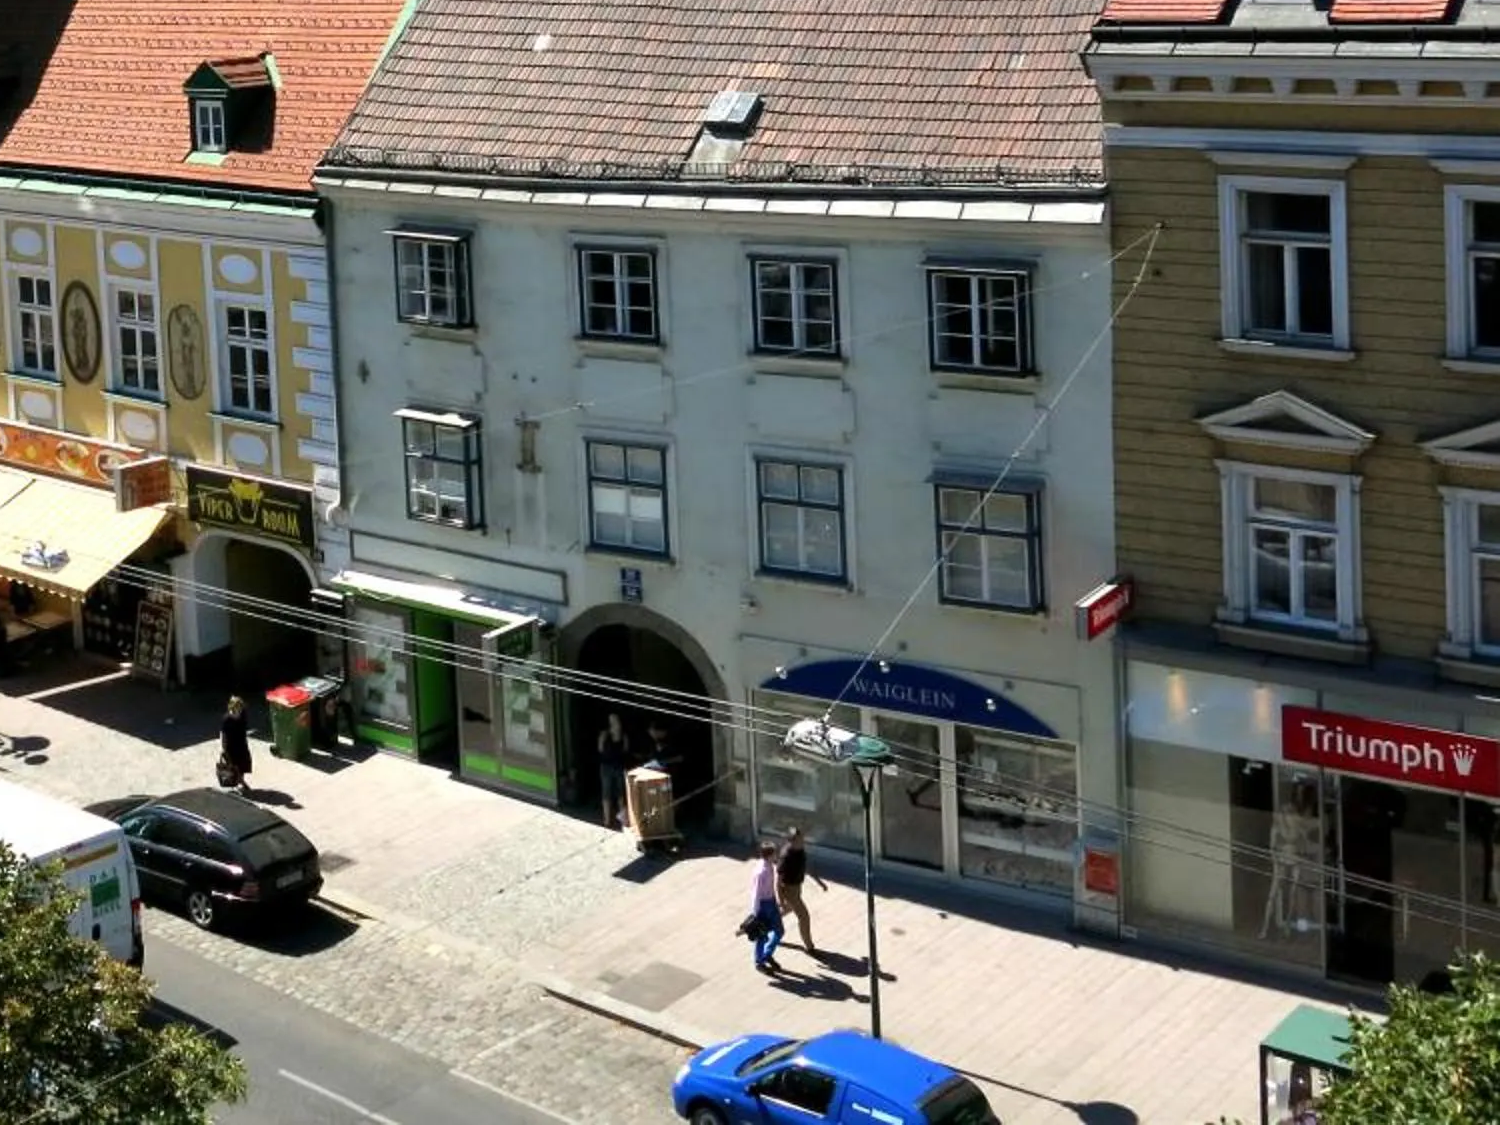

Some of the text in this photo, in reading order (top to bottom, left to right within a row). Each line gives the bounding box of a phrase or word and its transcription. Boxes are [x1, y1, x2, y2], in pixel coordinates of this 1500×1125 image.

[196, 489, 301, 538] VIPER ROOM
[850, 676, 956, 709] WAIGLEIN
[1301, 719, 1445, 773] Triumph
